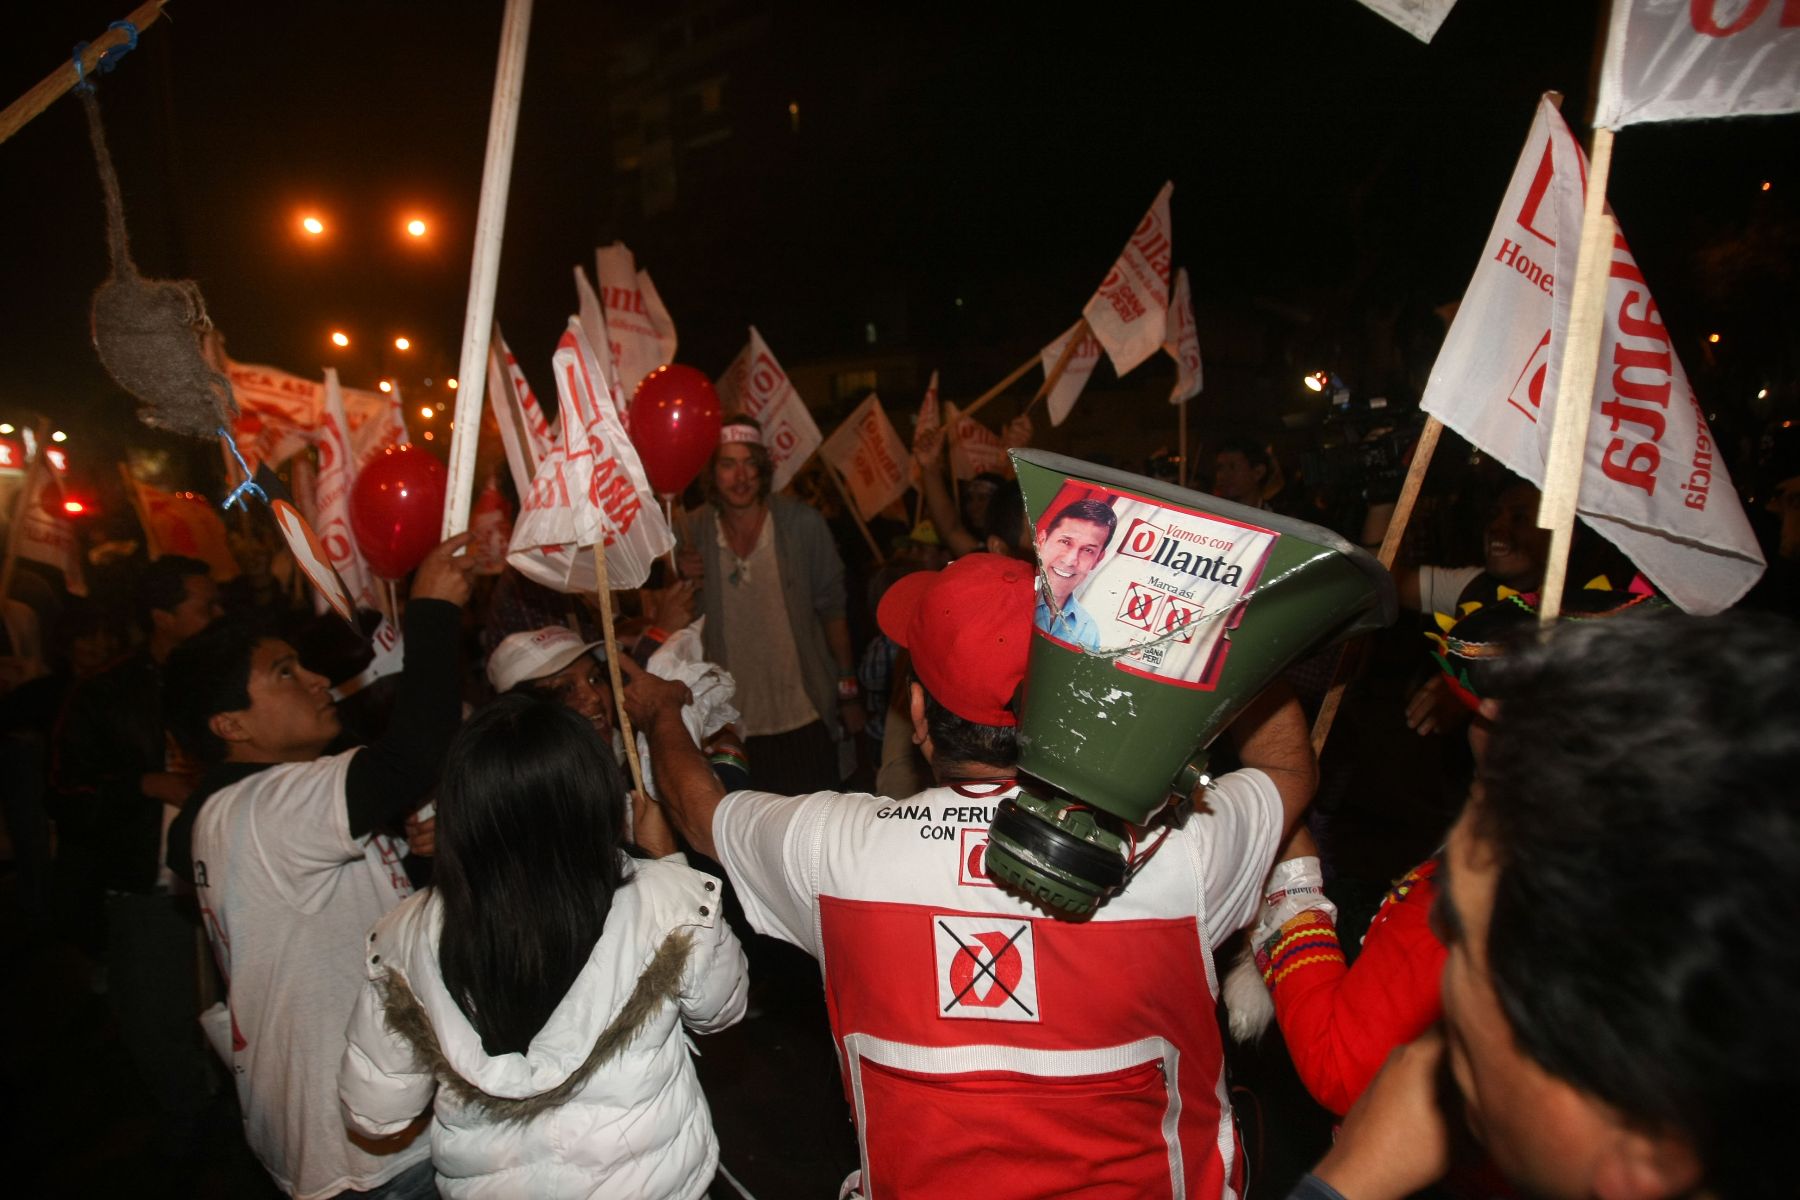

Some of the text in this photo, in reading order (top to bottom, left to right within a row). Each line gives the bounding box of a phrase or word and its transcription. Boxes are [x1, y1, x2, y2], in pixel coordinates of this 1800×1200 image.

[1495, 238, 1554, 297] Hone
[1166, 523, 1234, 552] Vamos con
[1130, 529, 1243, 588] Ollanta
[1148, 576, 1197, 600] Marca así
[876, 805, 997, 823] GANA PERU
[920, 825, 956, 841] CON
